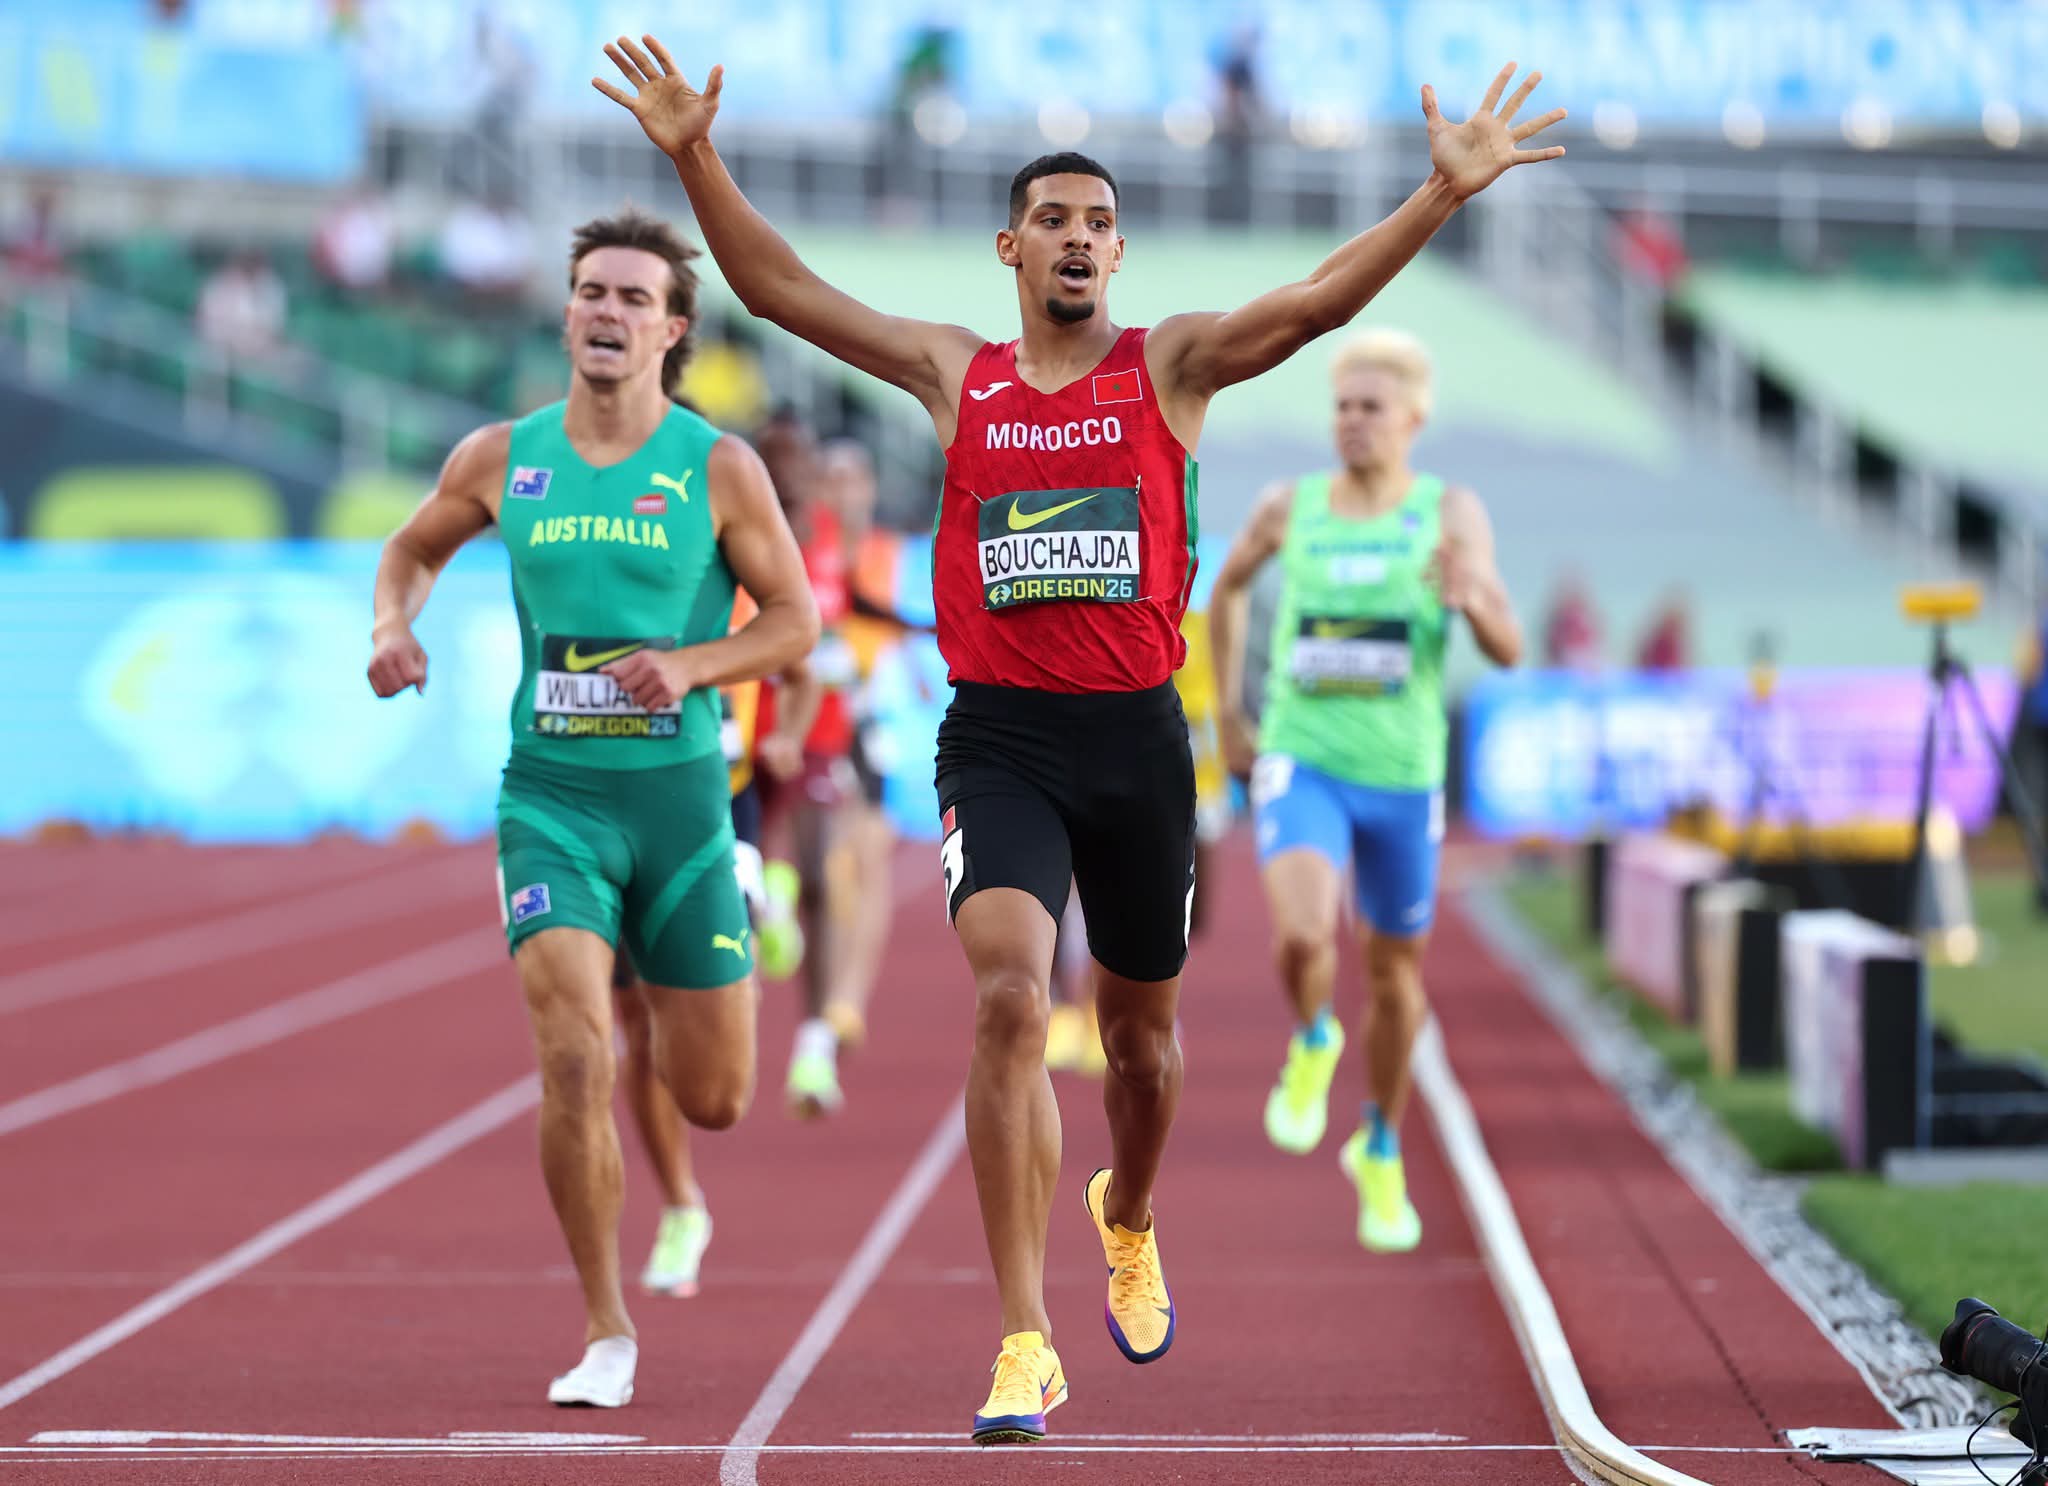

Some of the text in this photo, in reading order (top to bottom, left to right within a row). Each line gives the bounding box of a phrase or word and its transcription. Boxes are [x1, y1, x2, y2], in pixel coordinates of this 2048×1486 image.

[986, 416, 1122, 452] MOROCCO
[529, 515, 670, 550] AUSTRALIA
[985, 535, 1133, 578] BOUCHAJDA
[1012, 578, 1133, 601] OREGON26
[546, 676, 671, 709] WILLIA
[567, 715, 677, 736] OREGON26
